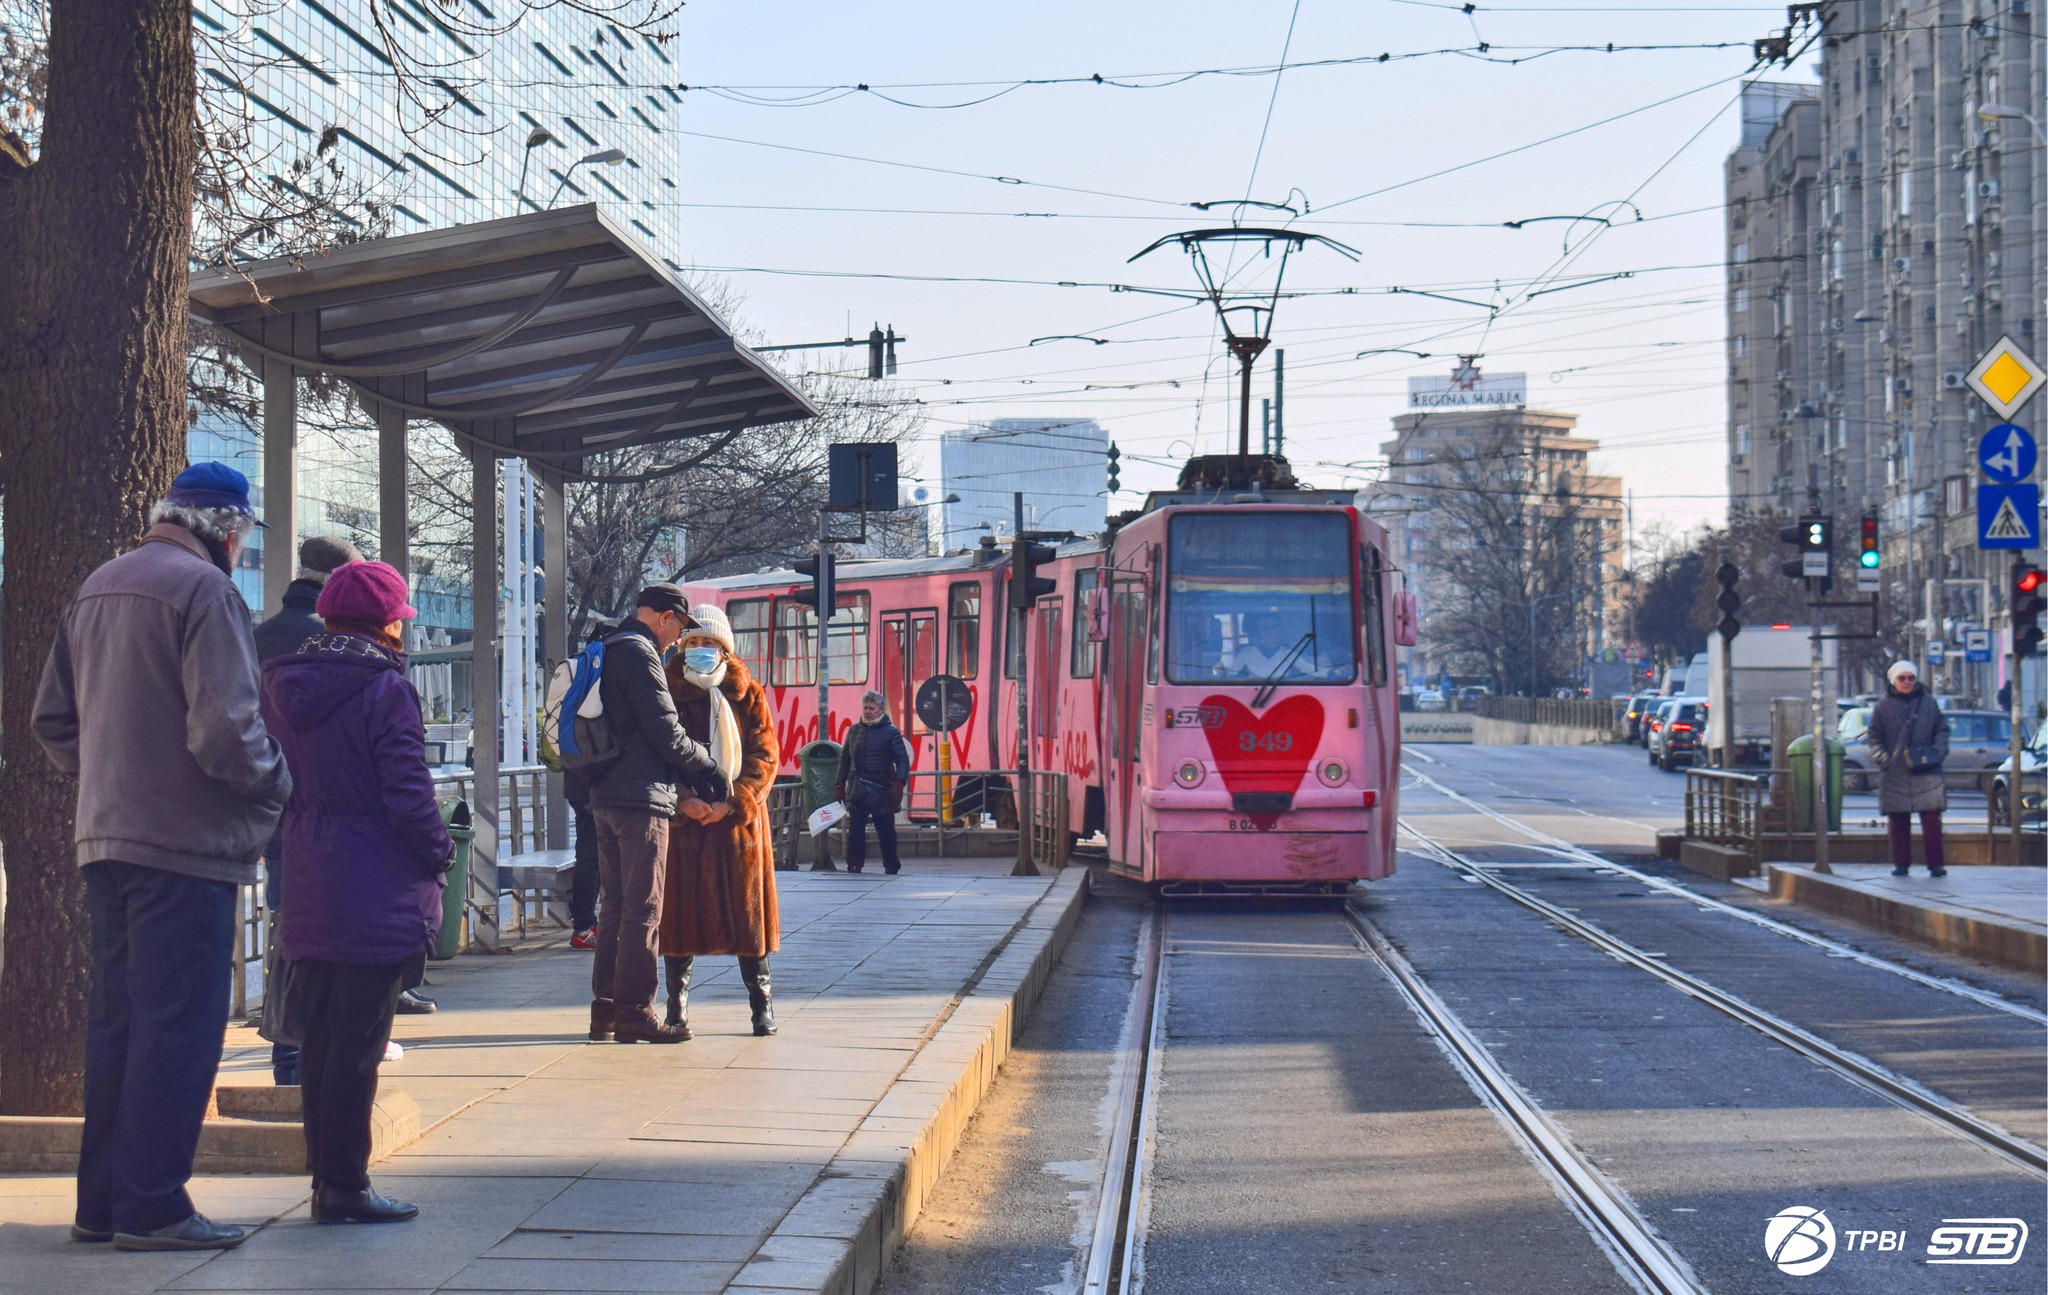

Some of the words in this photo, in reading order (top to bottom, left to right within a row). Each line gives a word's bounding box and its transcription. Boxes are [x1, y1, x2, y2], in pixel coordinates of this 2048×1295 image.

[1411, 393, 1467, 407] REGINA
[1472, 391, 1521, 405] MARIA
[1239, 730, 1293, 752] 349
[1229, 820, 1237, 830] B
